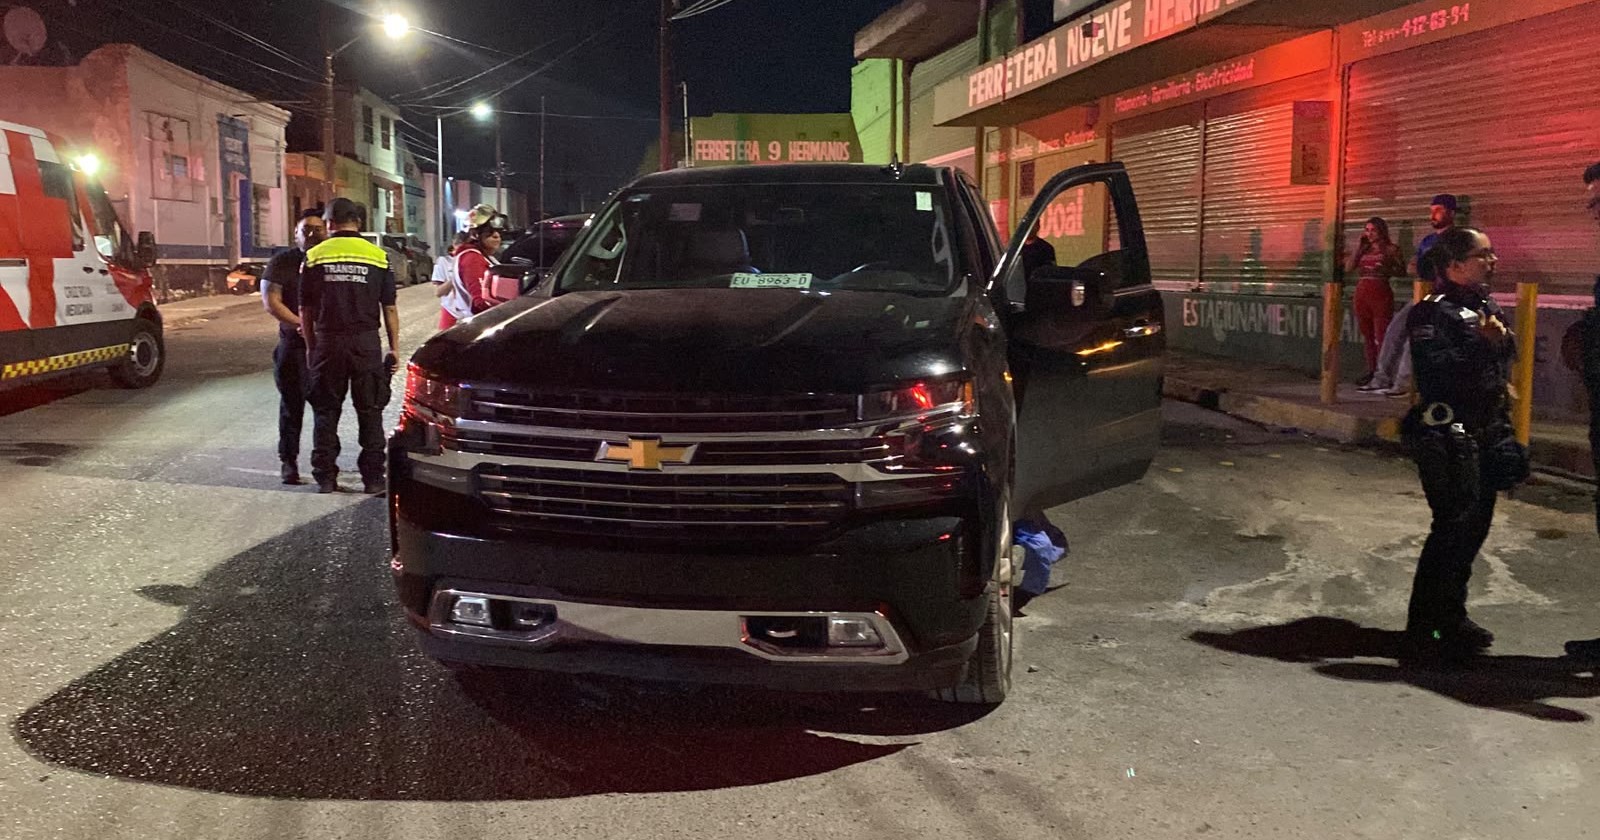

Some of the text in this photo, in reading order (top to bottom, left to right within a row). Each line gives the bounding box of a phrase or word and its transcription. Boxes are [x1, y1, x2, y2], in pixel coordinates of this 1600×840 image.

[969, 44, 1057, 107] FERRETERA
[1067, 4, 1132, 67] NUEVE
[695, 140, 850, 161] FERRETERA 9 HERMANOS
[323, 274, 369, 284] MUNICIPAL
[1183, 298, 1318, 338] ESTACIONAMIENTO
